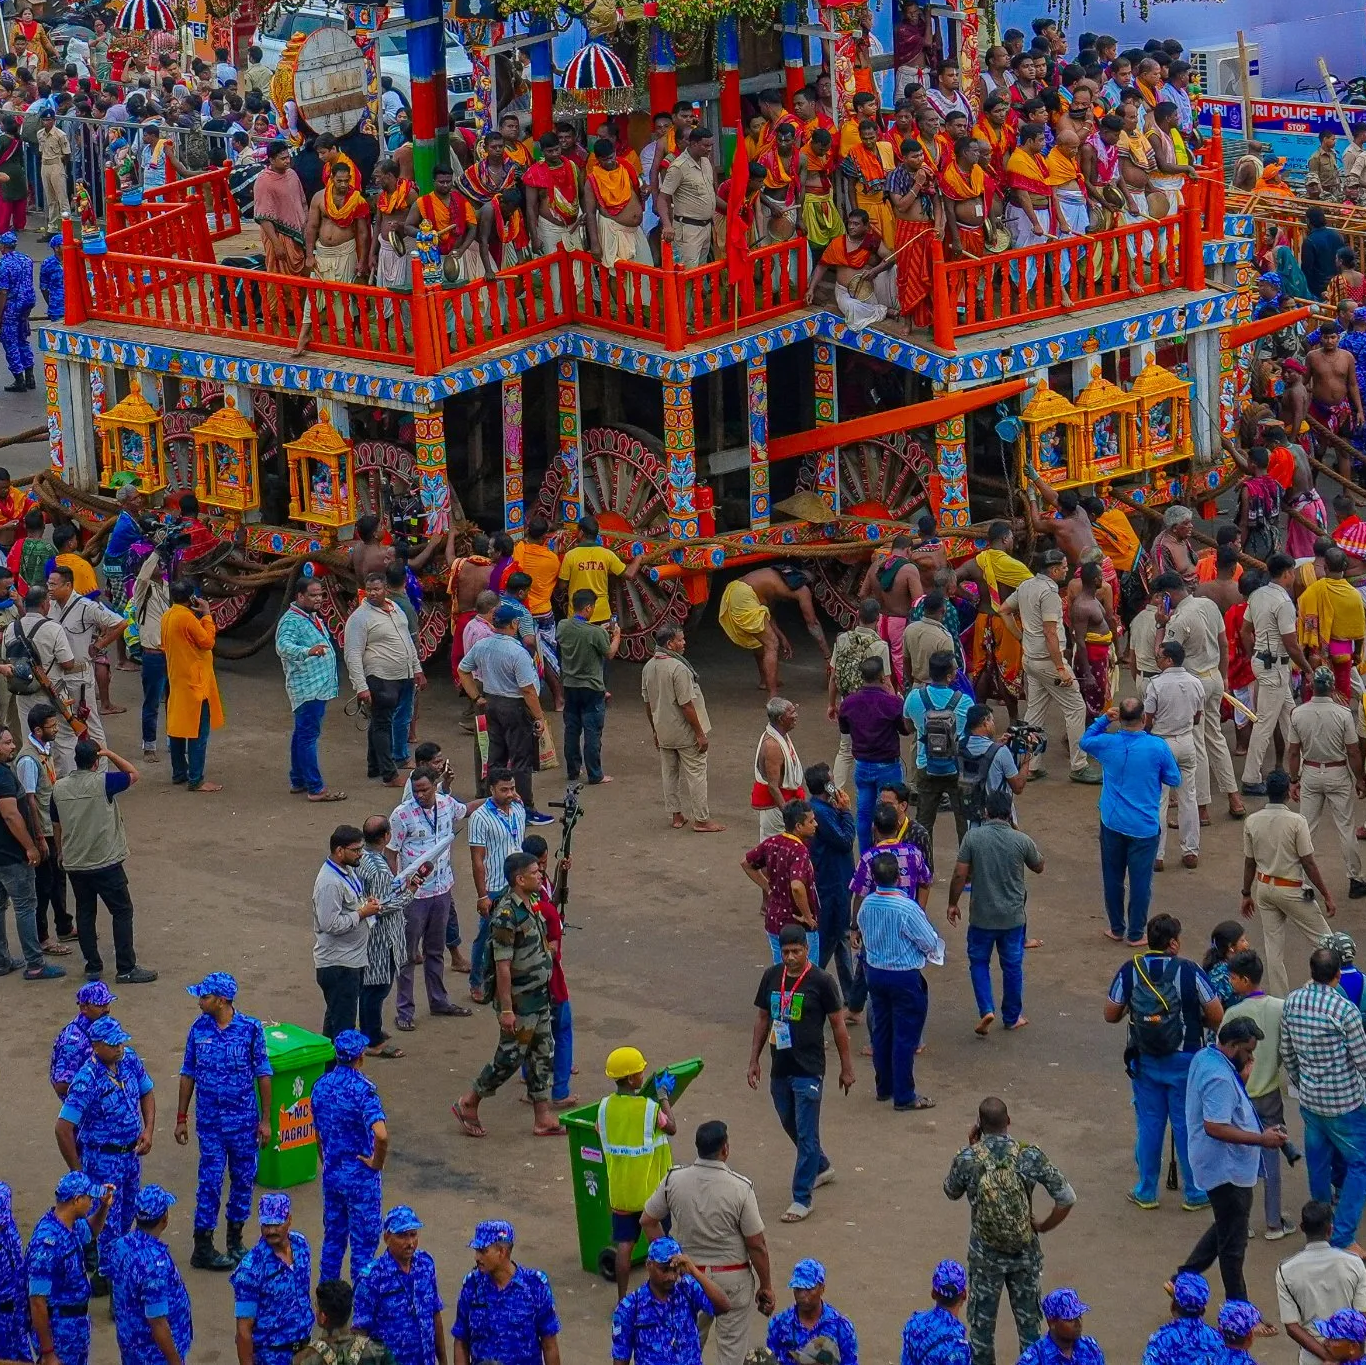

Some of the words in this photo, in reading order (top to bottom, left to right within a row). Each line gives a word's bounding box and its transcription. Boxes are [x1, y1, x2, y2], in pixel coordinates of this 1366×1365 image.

[1202, 102, 1227, 117] PURI
[1251, 104, 1268, 117] URI
[1272, 105, 1322, 124] POLICE,
[1325, 109, 1356, 124] PURI
[1287, 124, 1306, 132] STOP
[578, 561, 605, 571] SJTA
[280, 1124, 314, 1143] JAGRUT
